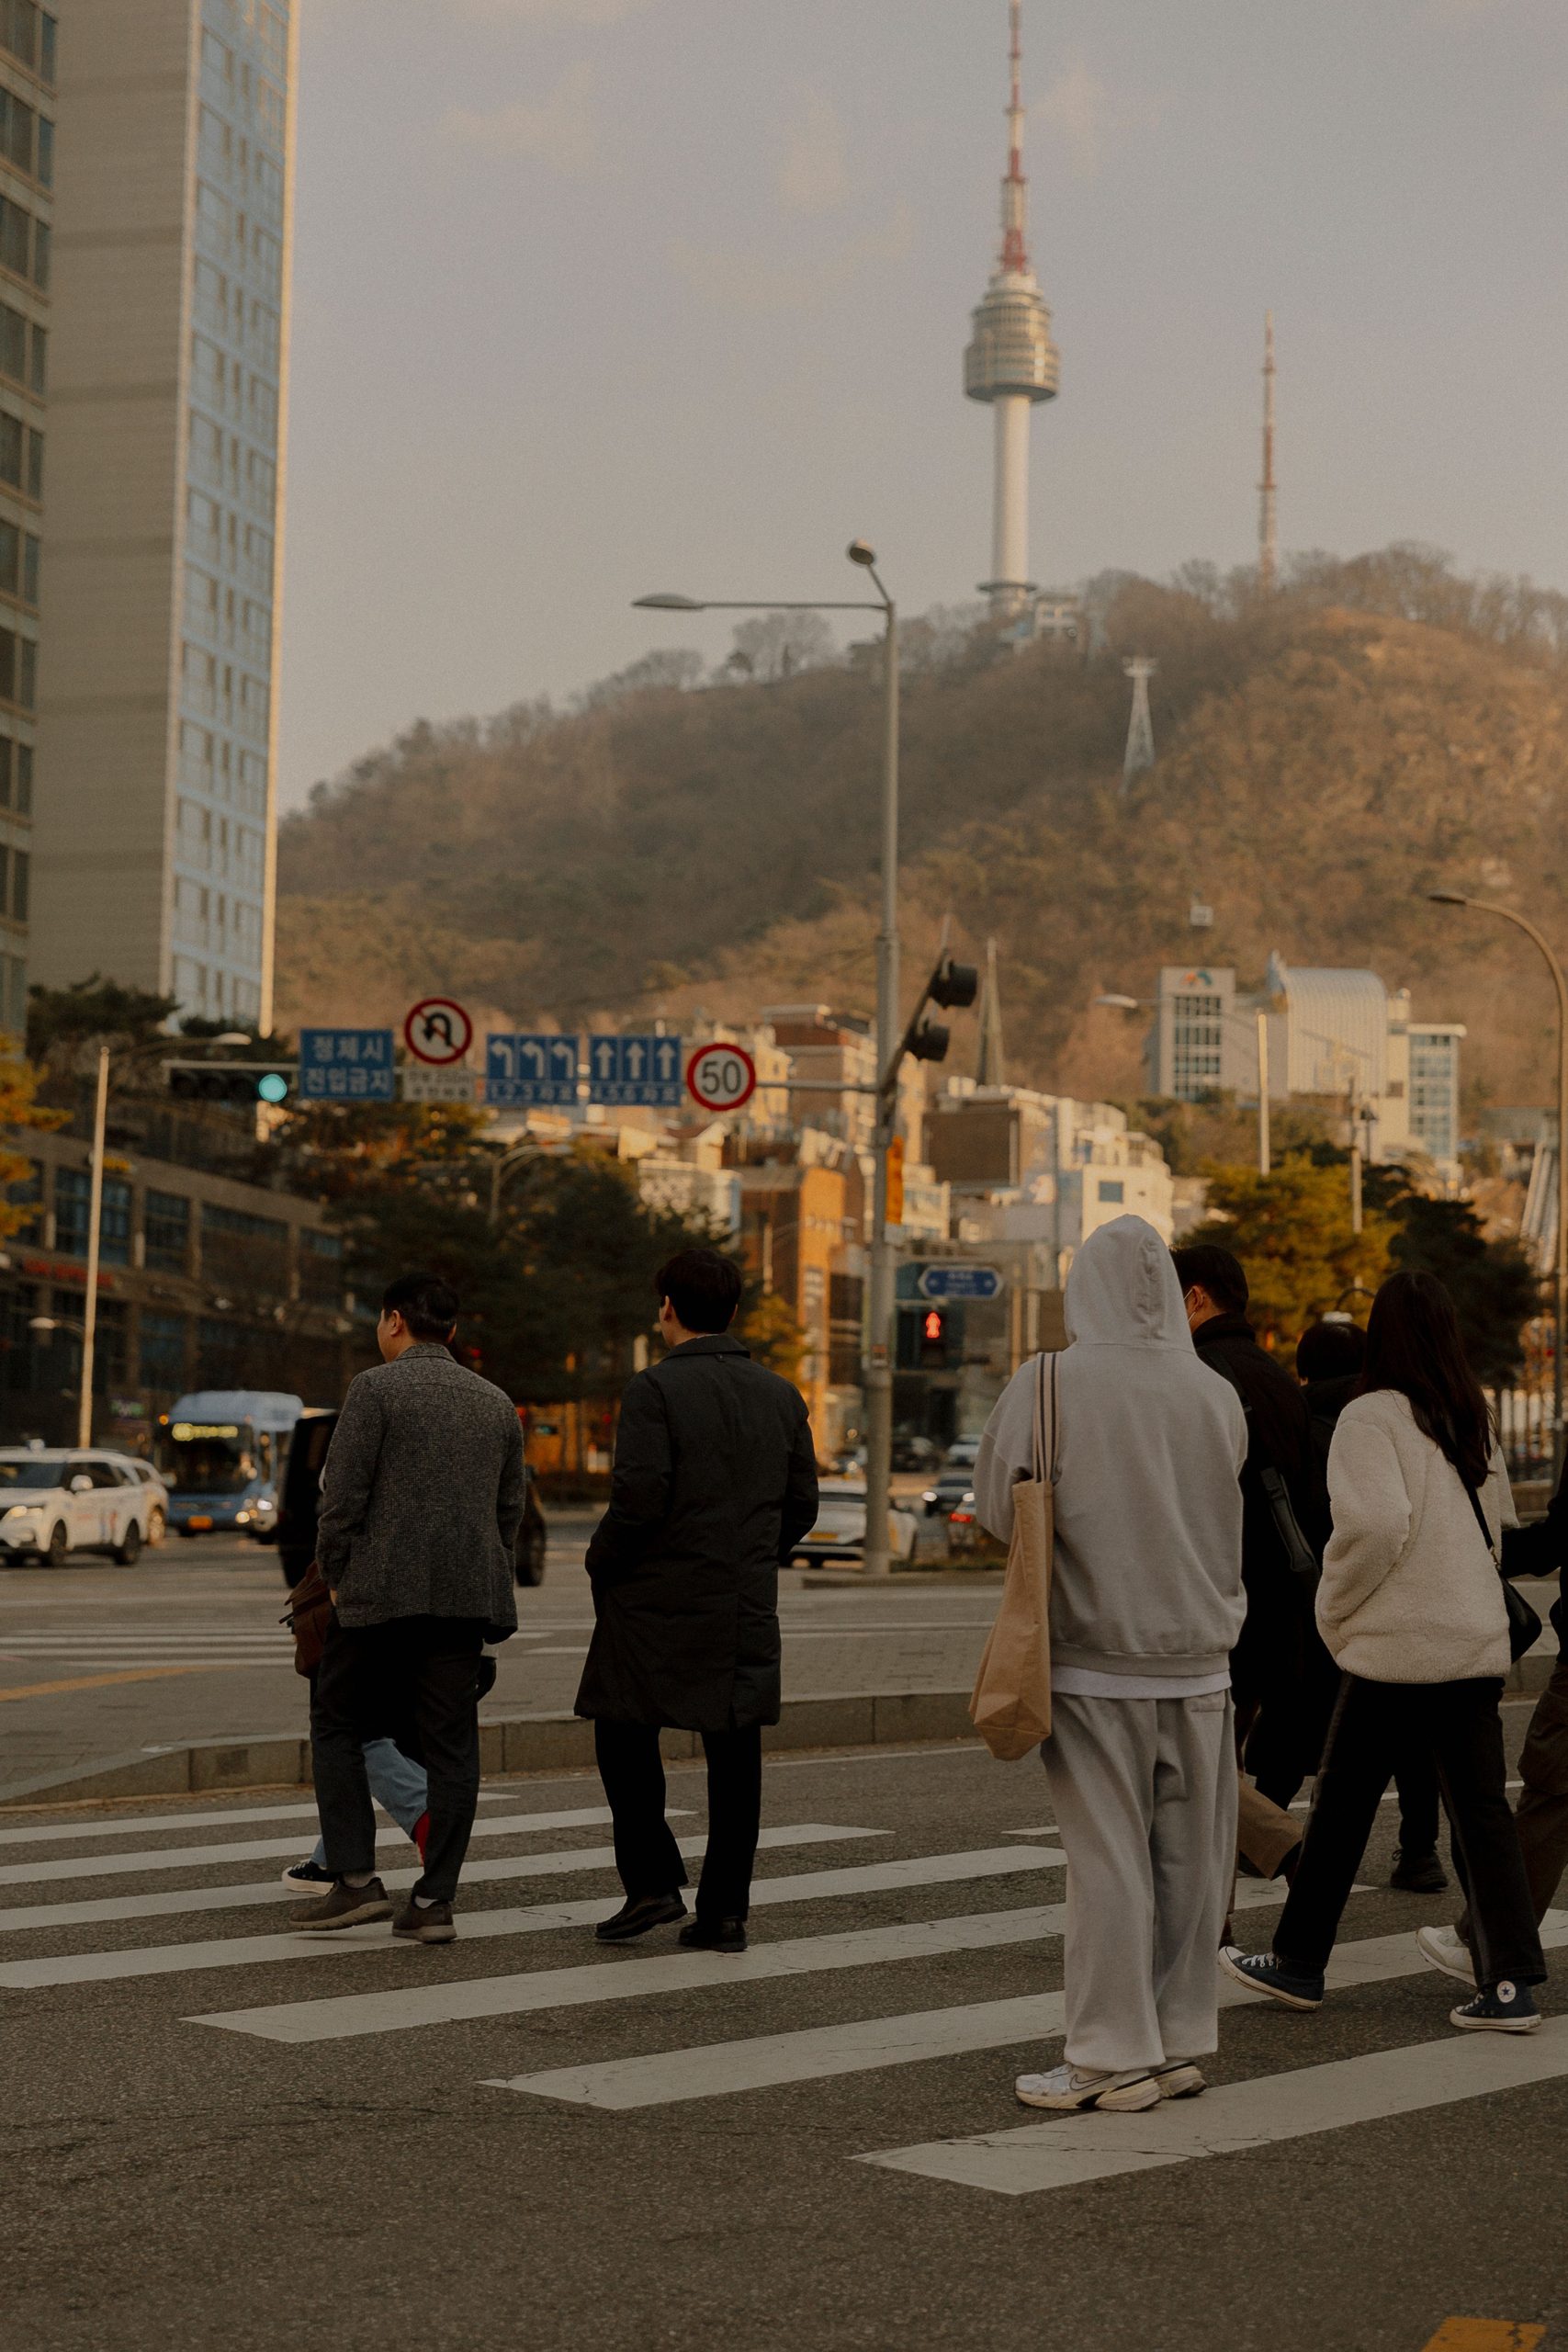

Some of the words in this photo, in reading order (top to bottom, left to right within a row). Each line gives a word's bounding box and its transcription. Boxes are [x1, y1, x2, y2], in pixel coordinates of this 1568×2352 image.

[313, 1035, 384, 1062] 정체시
[306, 1067, 389, 1094] 진입금지
[702, 1059, 741, 1094] 50
